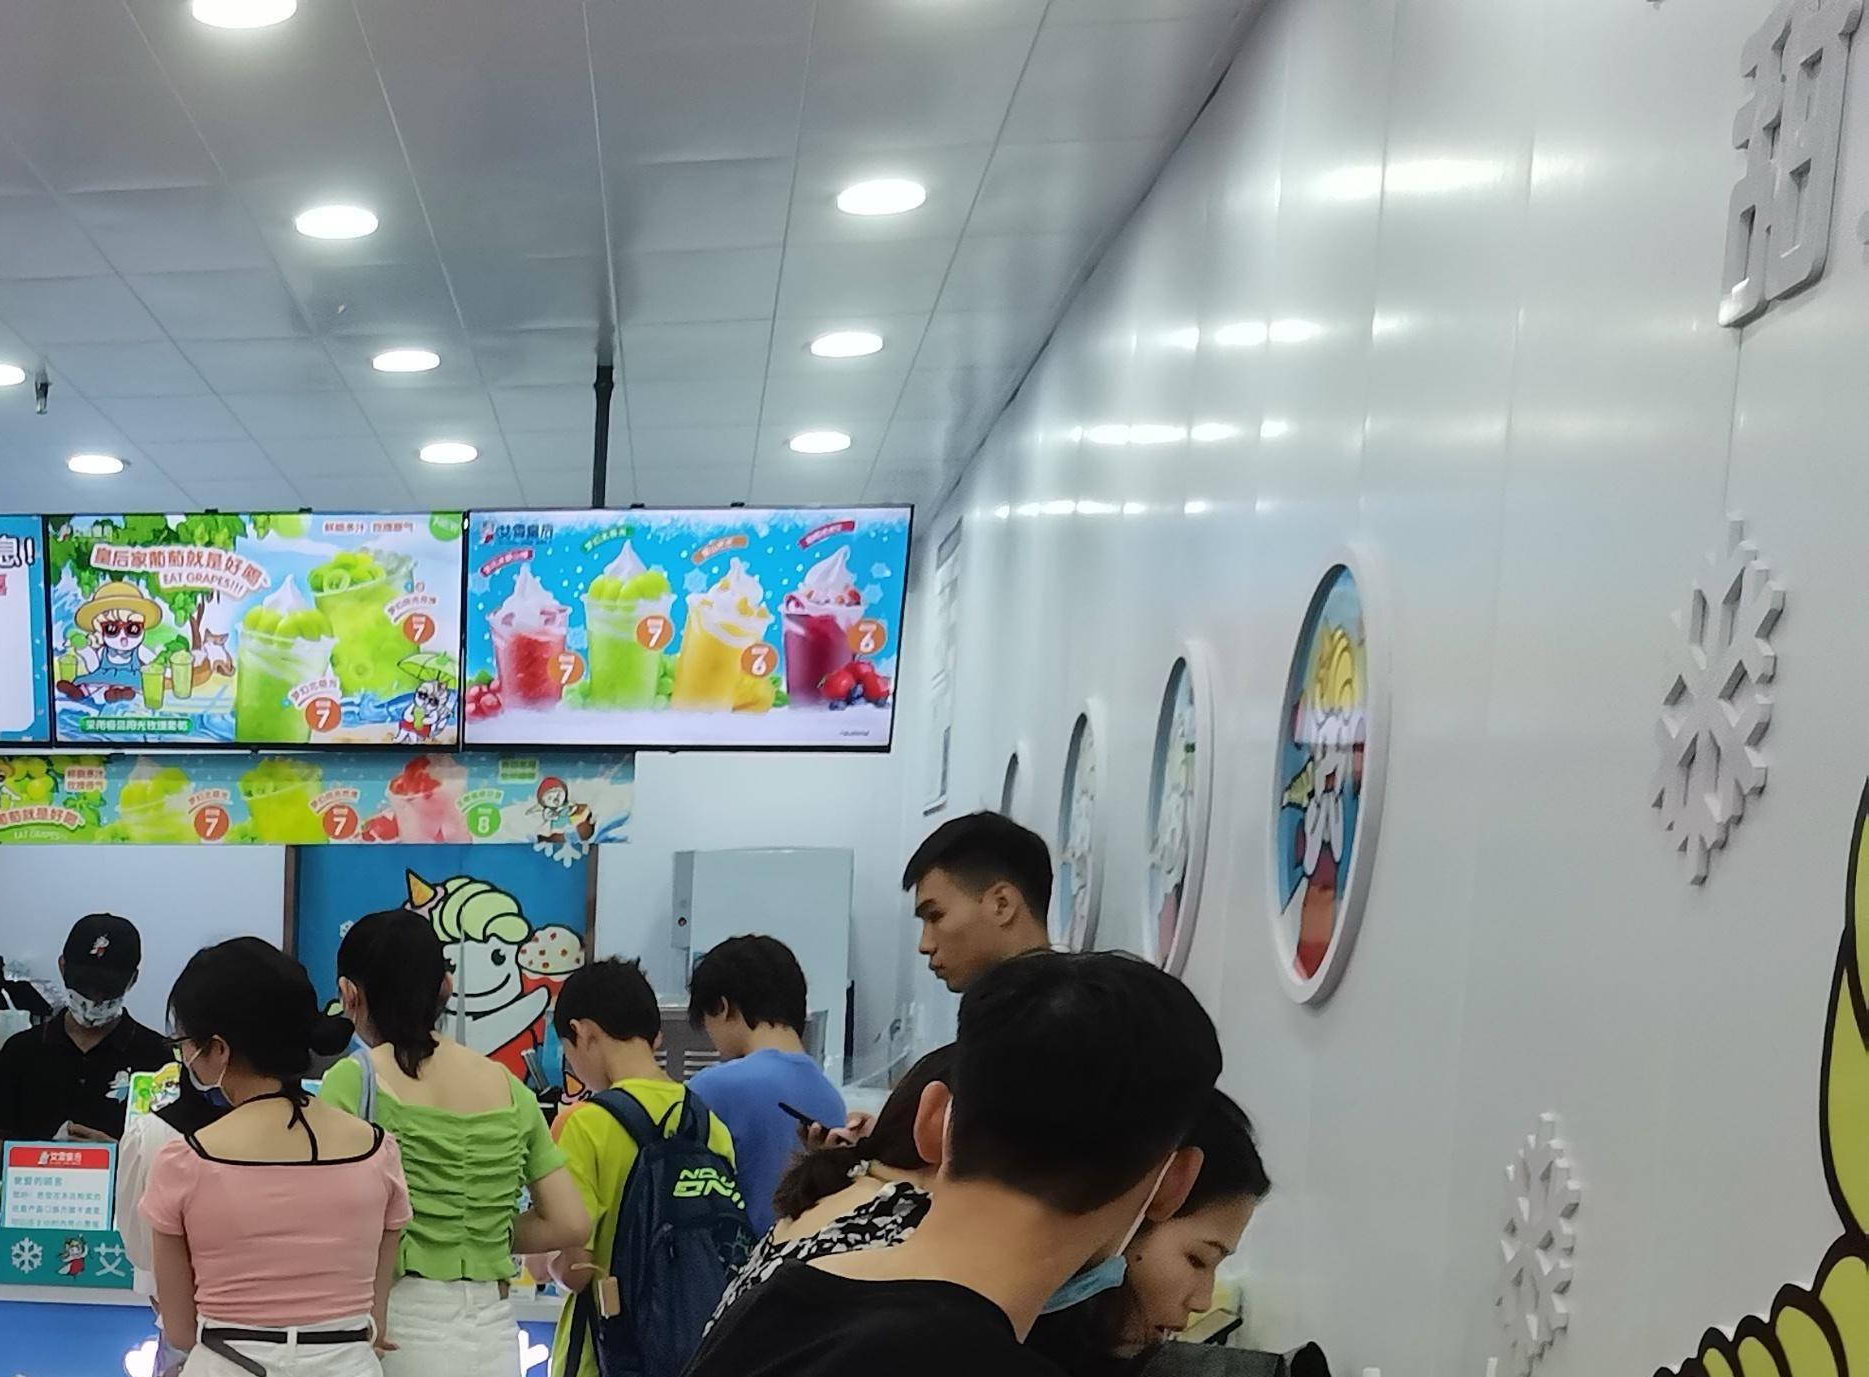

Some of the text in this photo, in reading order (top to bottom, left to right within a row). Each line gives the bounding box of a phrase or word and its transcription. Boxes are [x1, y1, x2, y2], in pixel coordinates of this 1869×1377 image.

[163, 573, 183, 585] EAT
[205, 817, 219, 837] 7
[333, 817, 347, 836] 7
